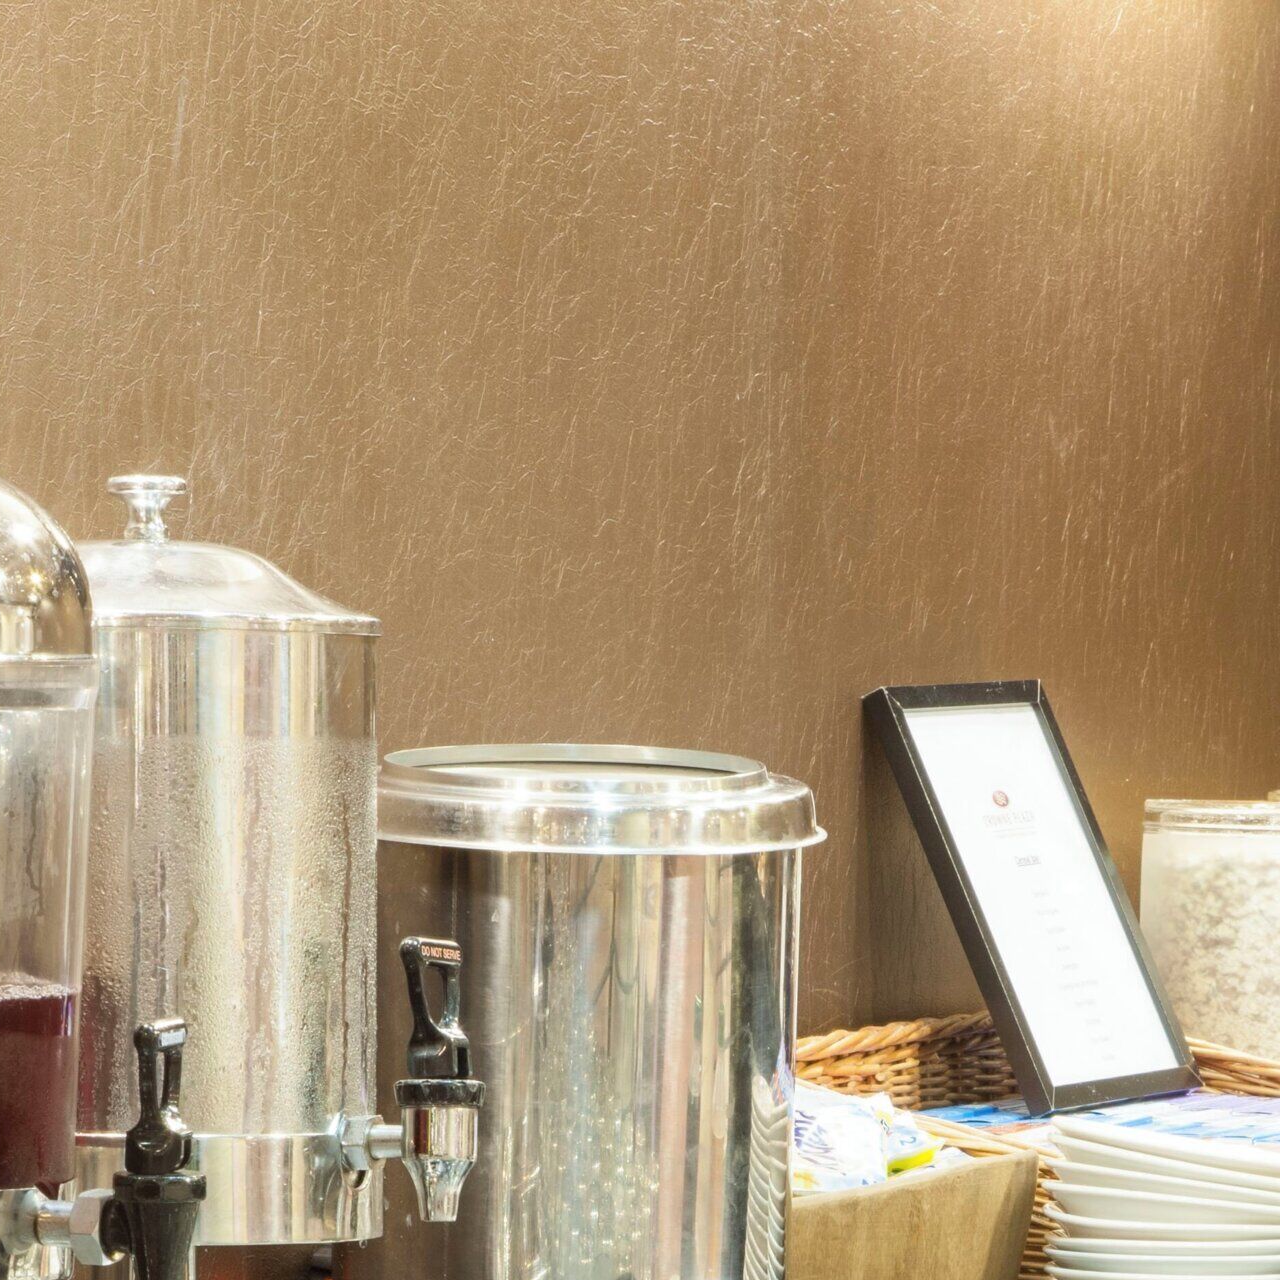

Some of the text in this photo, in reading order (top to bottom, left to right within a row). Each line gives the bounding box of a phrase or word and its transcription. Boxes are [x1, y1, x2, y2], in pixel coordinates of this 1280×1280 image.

[421, 945, 461, 961] DO NOT SERVE
